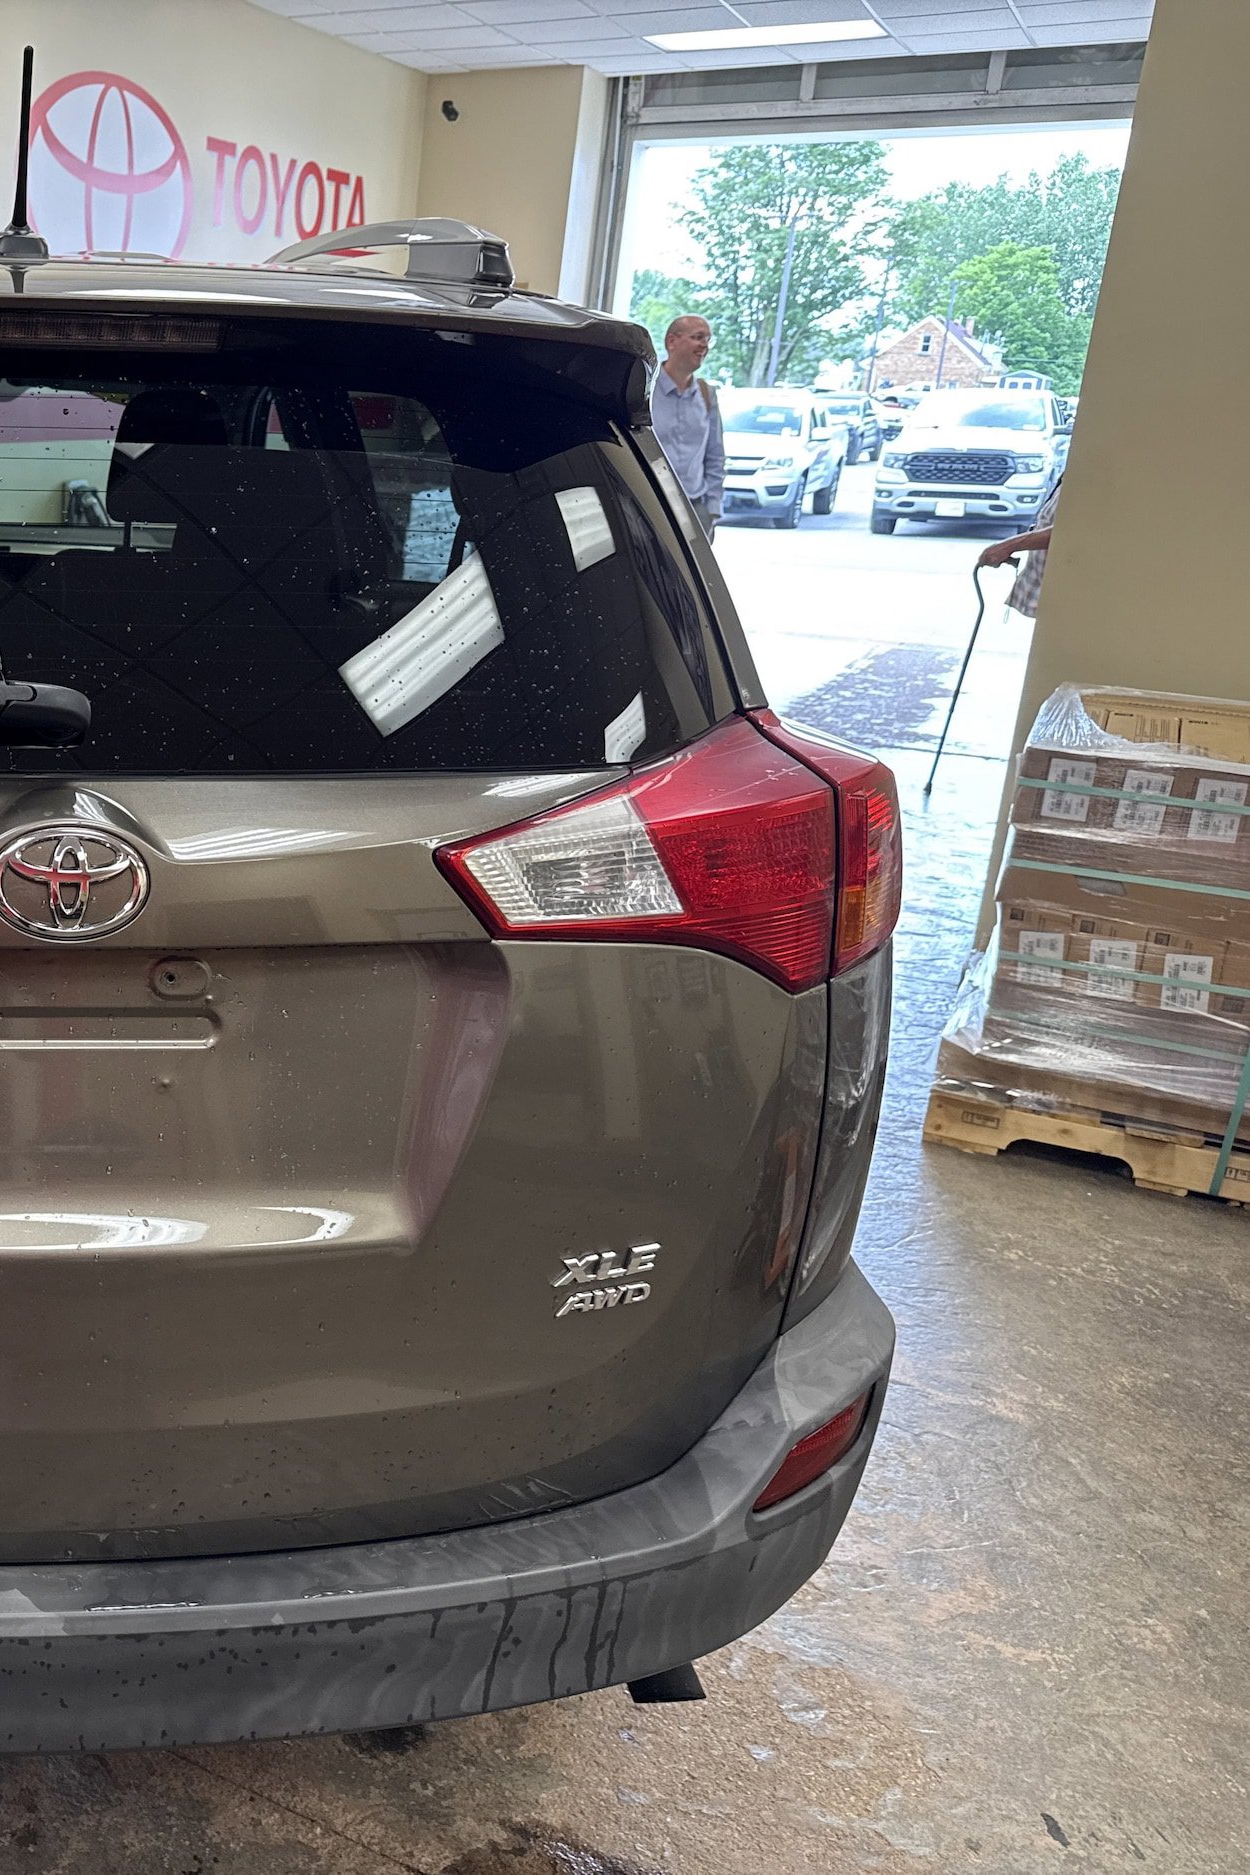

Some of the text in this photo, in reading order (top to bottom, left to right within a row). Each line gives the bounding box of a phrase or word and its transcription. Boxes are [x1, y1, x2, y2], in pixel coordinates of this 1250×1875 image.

[206, 136, 366, 240] TOYOTA
[551, 1242, 661, 1287] XLE
[555, 1282, 650, 1317] AWD
